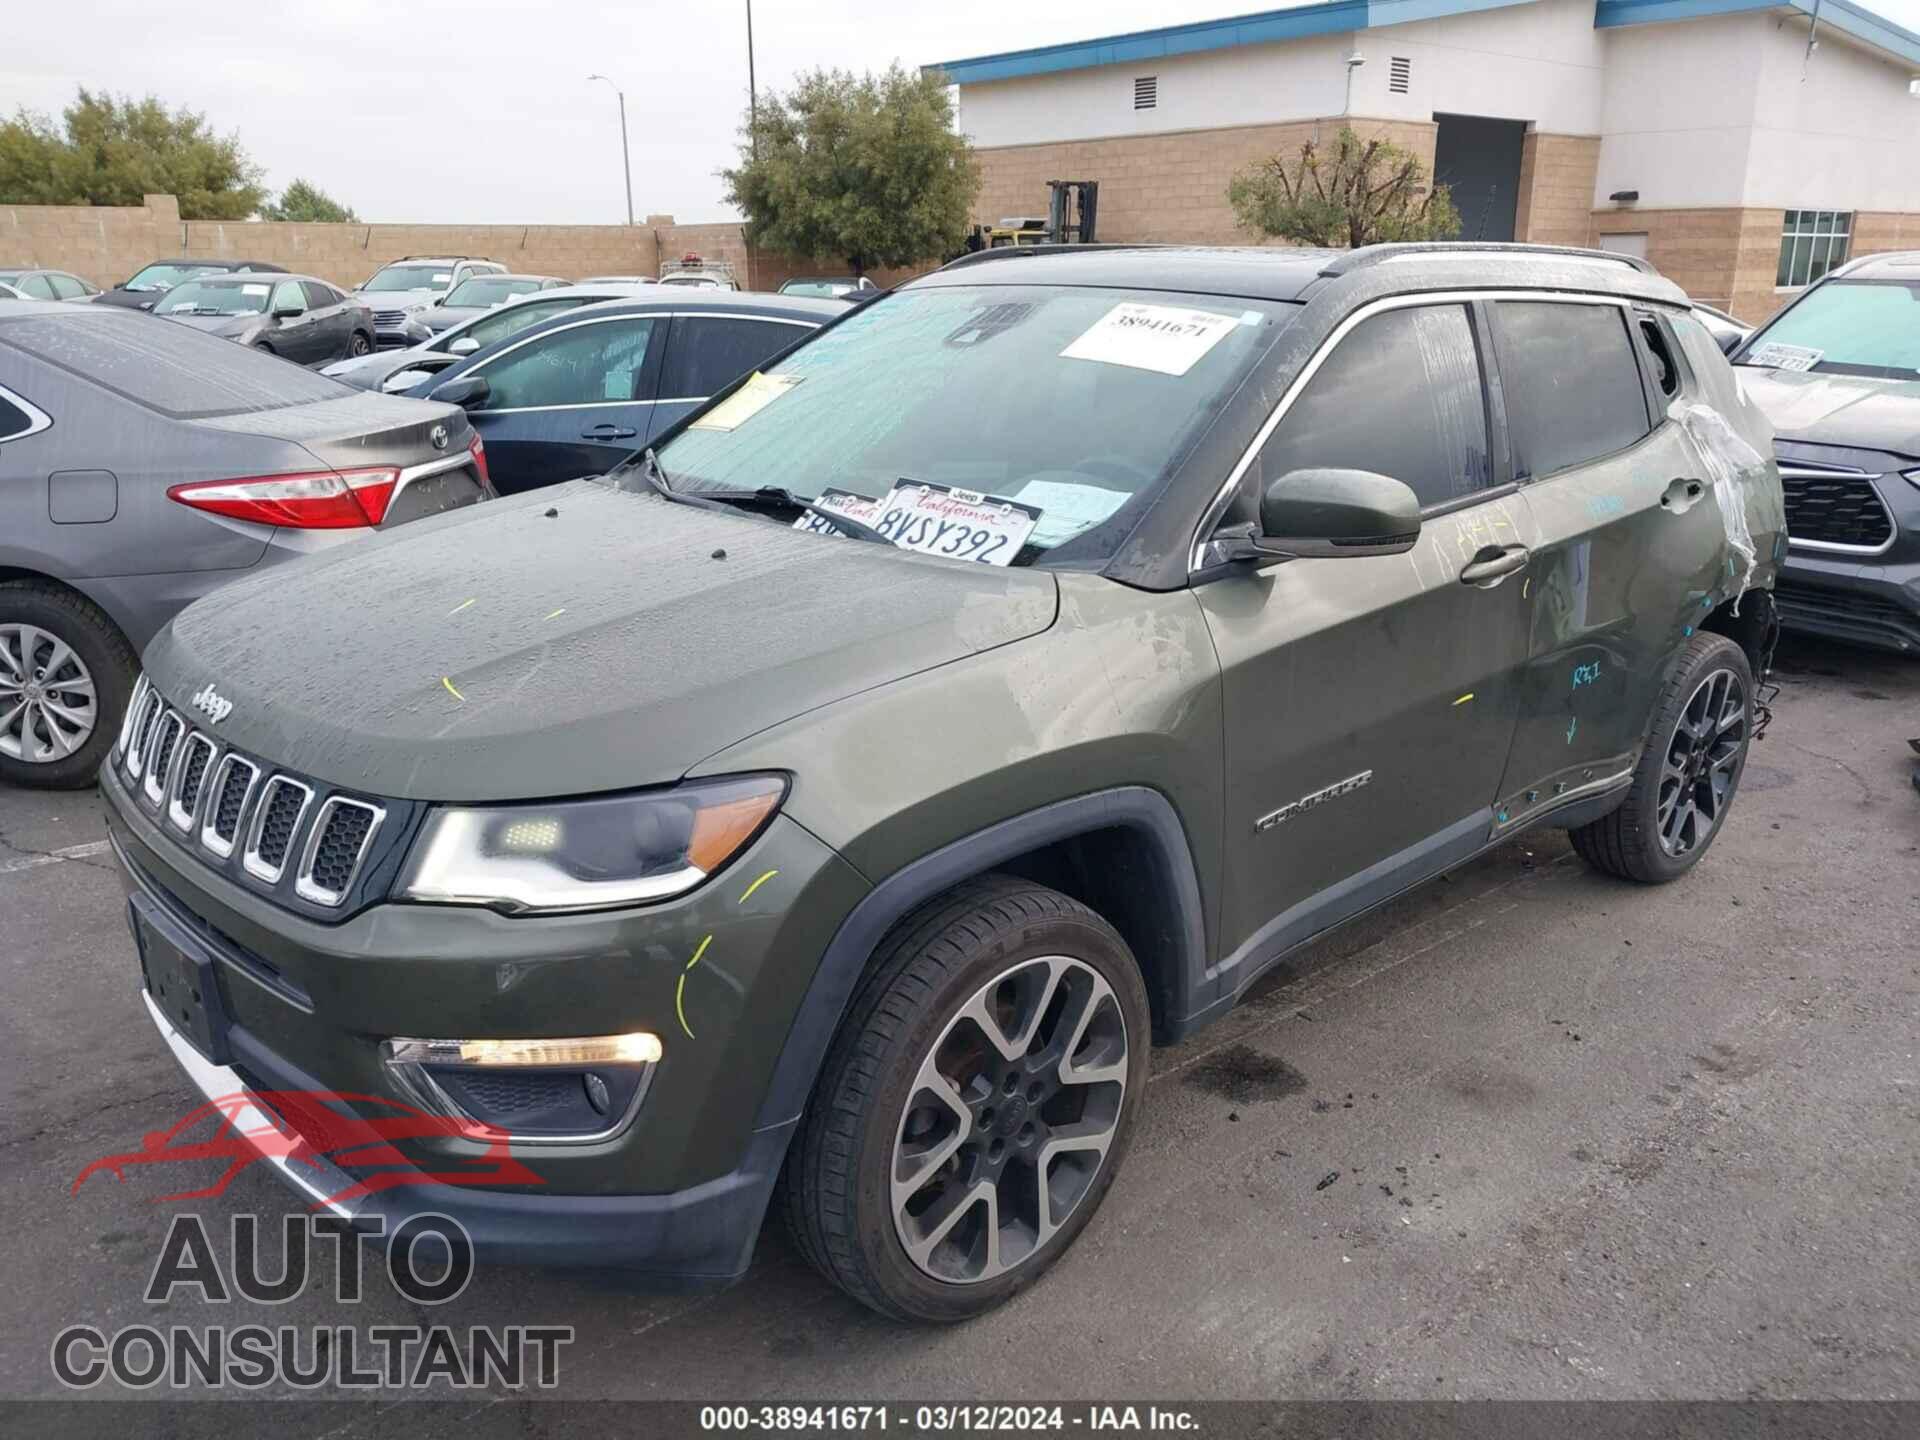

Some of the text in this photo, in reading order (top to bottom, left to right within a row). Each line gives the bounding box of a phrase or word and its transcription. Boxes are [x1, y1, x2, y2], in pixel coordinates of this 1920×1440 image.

[1118, 314, 1209, 337] 38941671
[915, 493, 1000, 526] California
[952, 487, 979, 503] Jeep
[875, 508, 1009, 565] 8VSY392
[191, 682, 233, 725] Jeep
[1253, 768, 1373, 833] COMPASS
